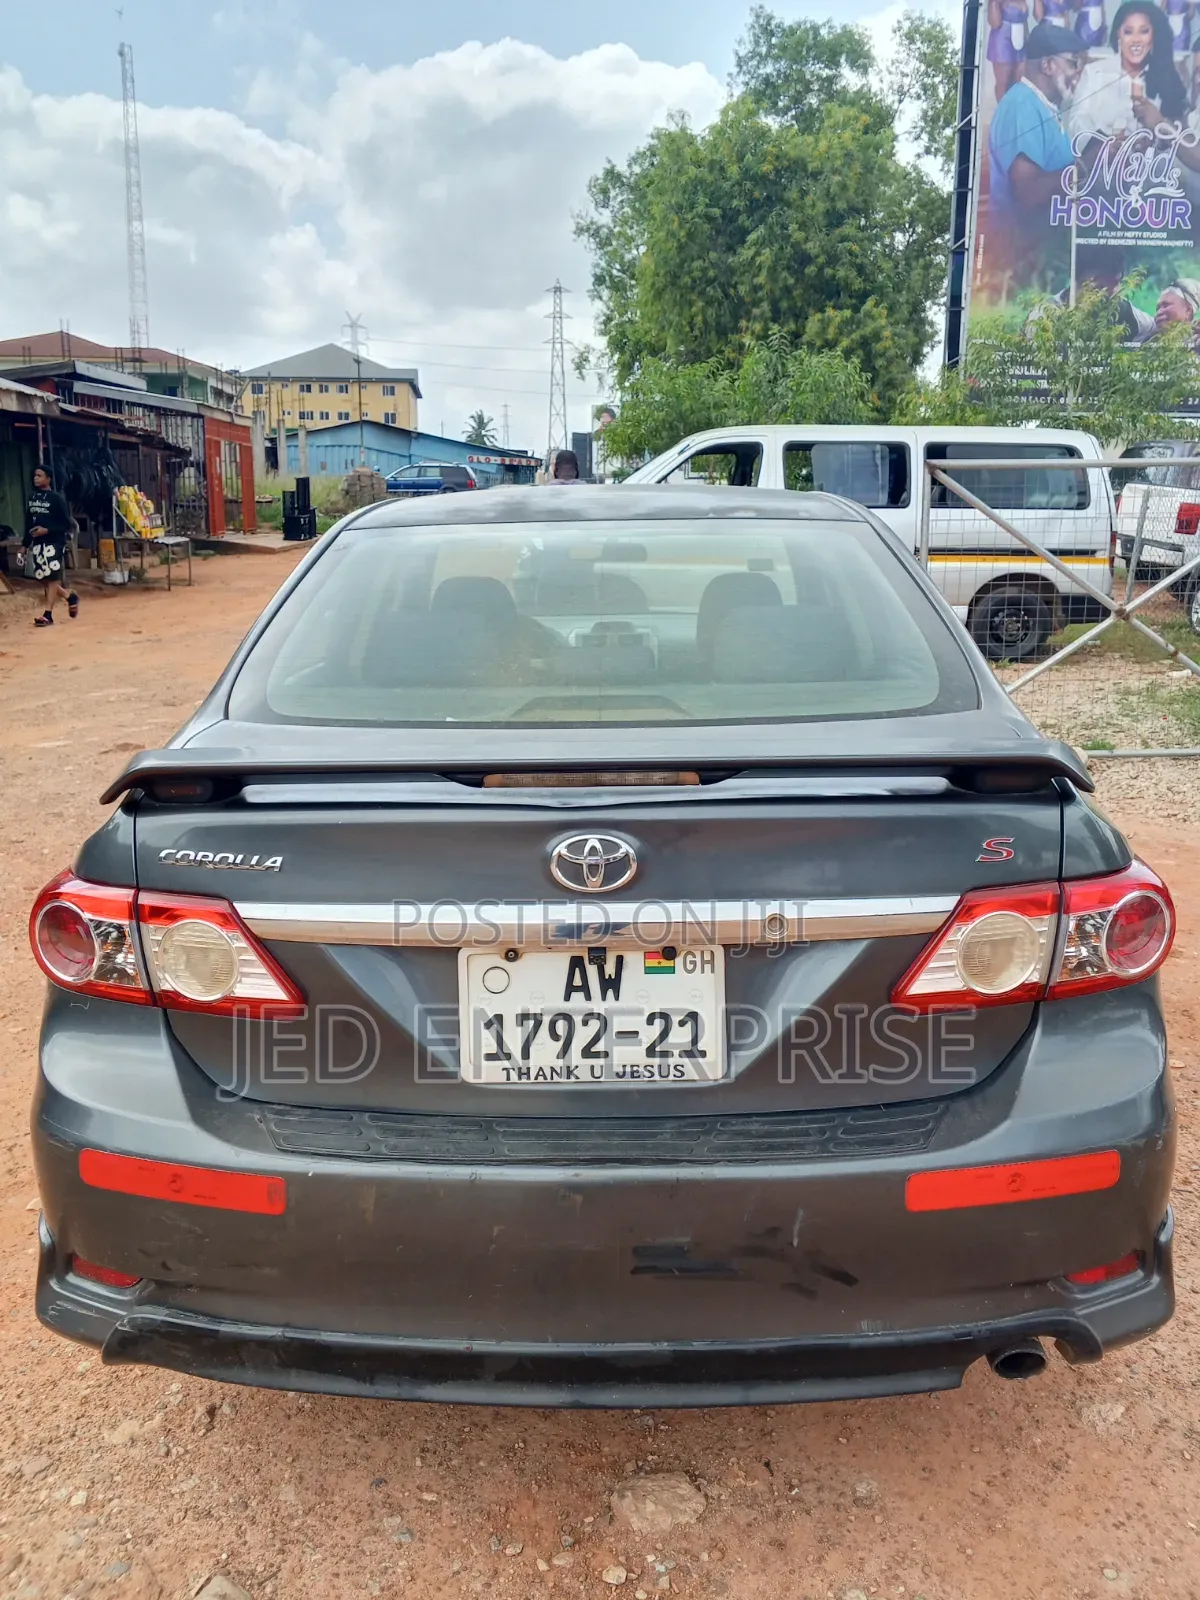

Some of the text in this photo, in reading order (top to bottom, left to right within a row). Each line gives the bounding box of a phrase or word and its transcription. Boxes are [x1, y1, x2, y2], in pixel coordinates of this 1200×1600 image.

[1050, 195, 1192, 229] HONOUR
[158, 849, 283, 872] COROLLA
[974, 837, 1015, 863] S
[682, 949, 715, 975] GH
[563, 954, 624, 1002] AW
[482, 1010, 708, 1062] 1792-21
[502, 1063, 686, 1082] THANK U JESUS
